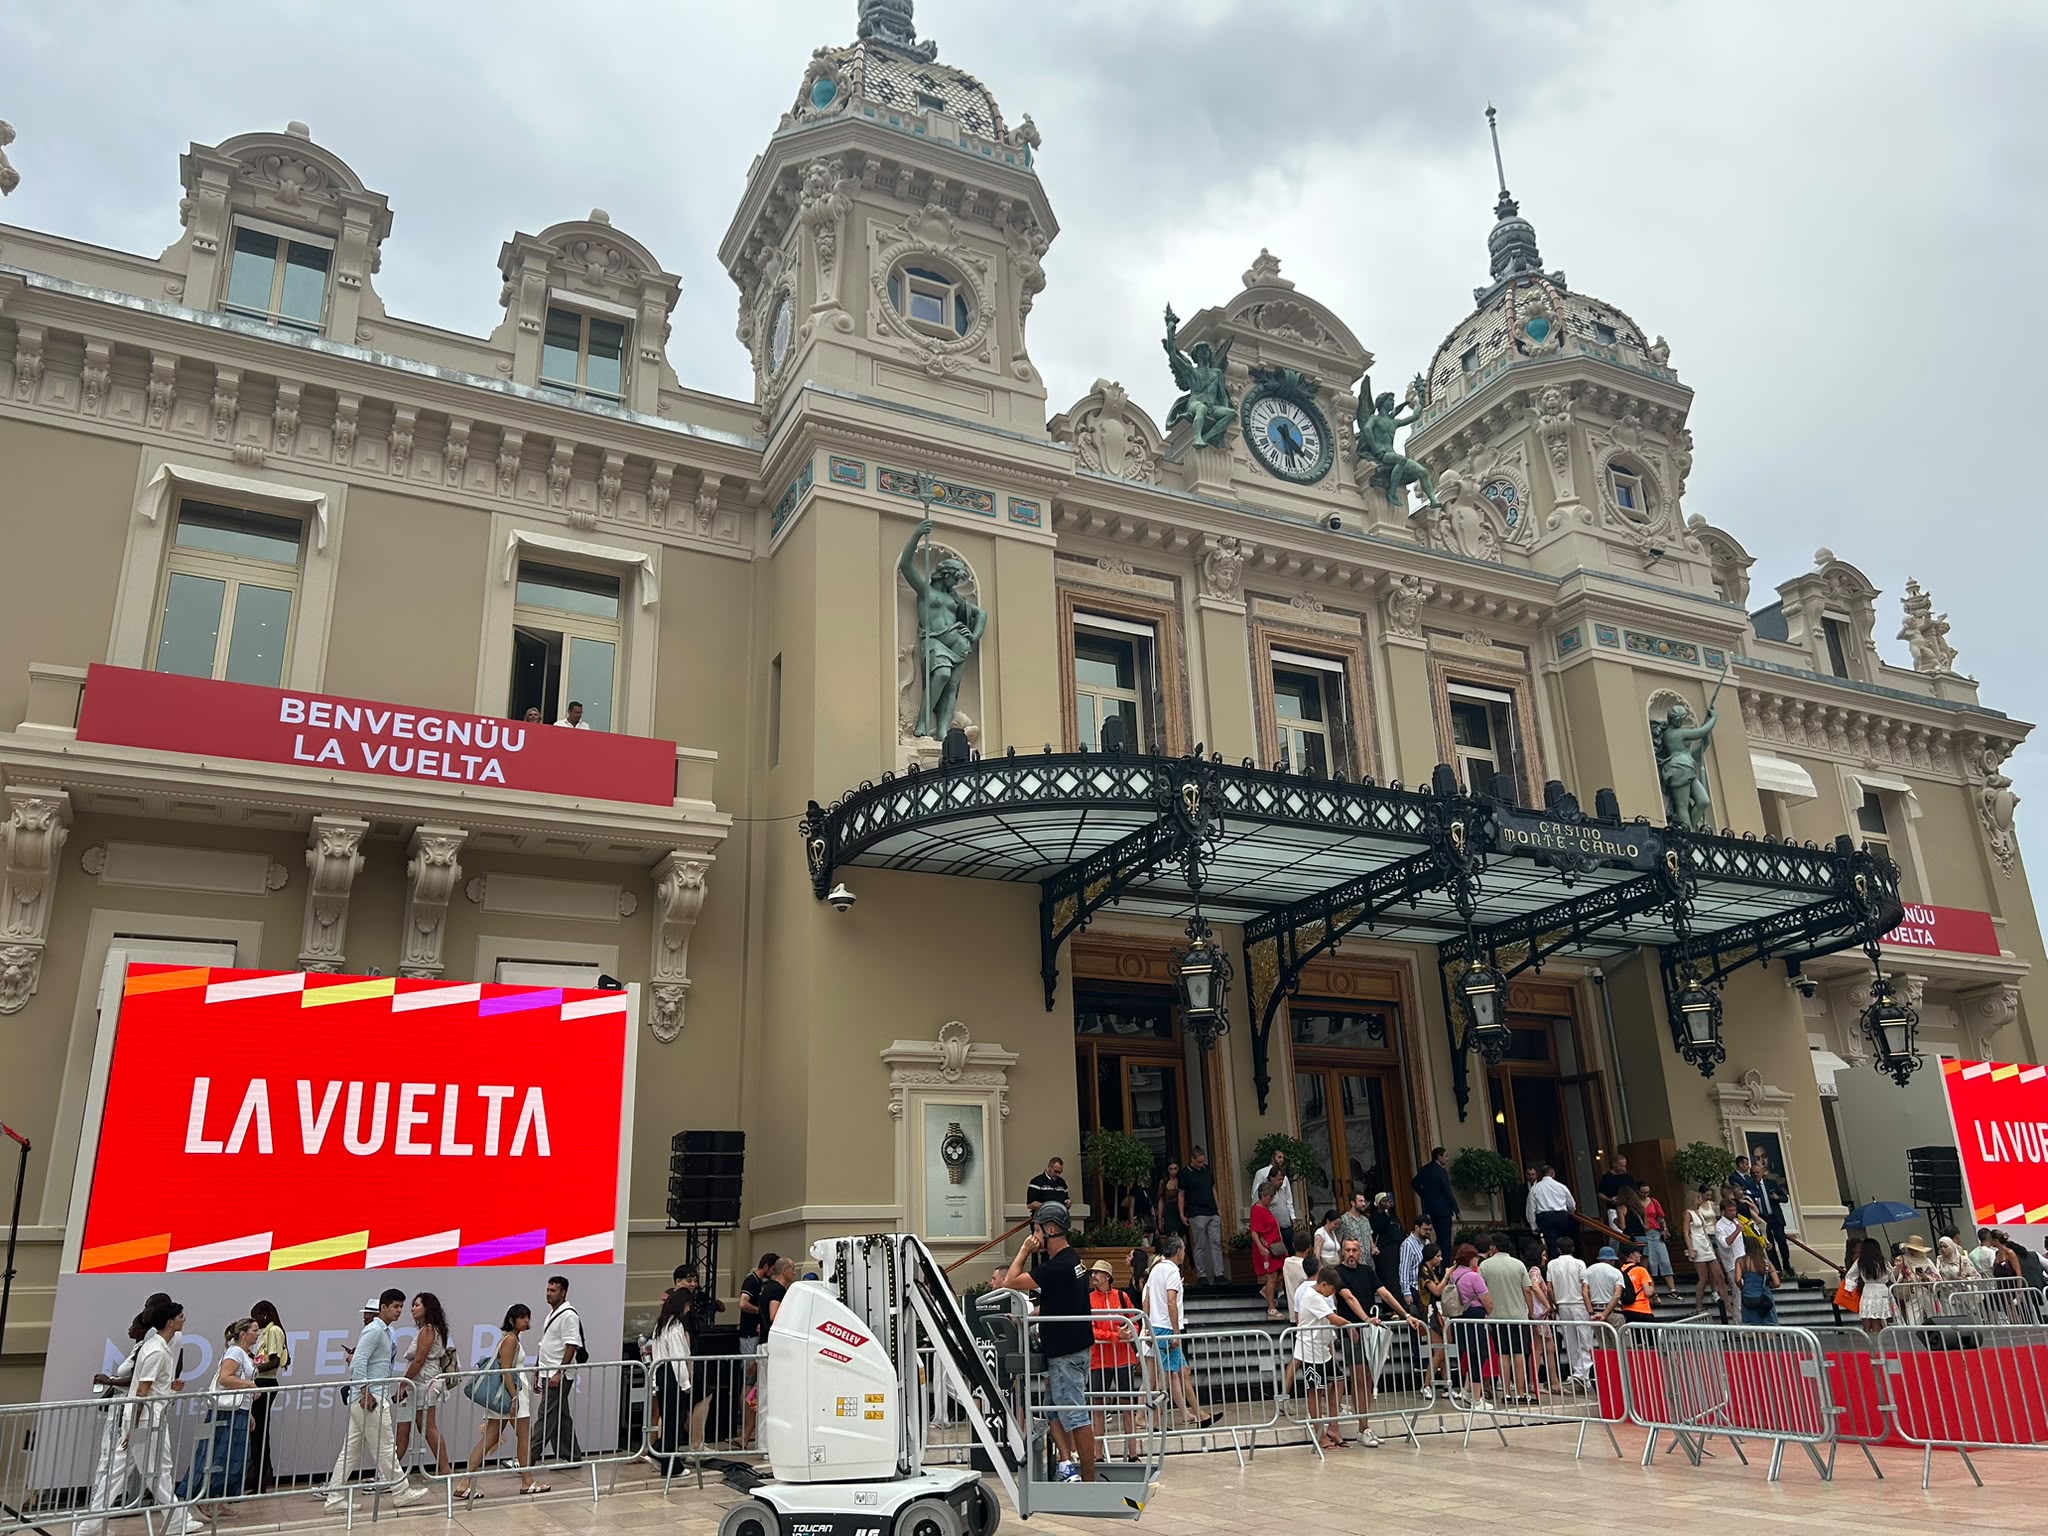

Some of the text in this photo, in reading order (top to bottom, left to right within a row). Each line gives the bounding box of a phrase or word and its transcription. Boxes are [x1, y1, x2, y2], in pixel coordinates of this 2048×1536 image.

[280, 698, 526, 752] BENVEGNÜU
[293, 734, 506, 784] LA VUELTA
[1539, 821, 1601, 840] CASINO
[184, 1076, 551, 1157] LA VUELTA
[1973, 1119, 2010, 1162] LA
[824, 1323, 861, 1345] SUDELEV
[792, 1524, 833, 1533] TOUCAN
